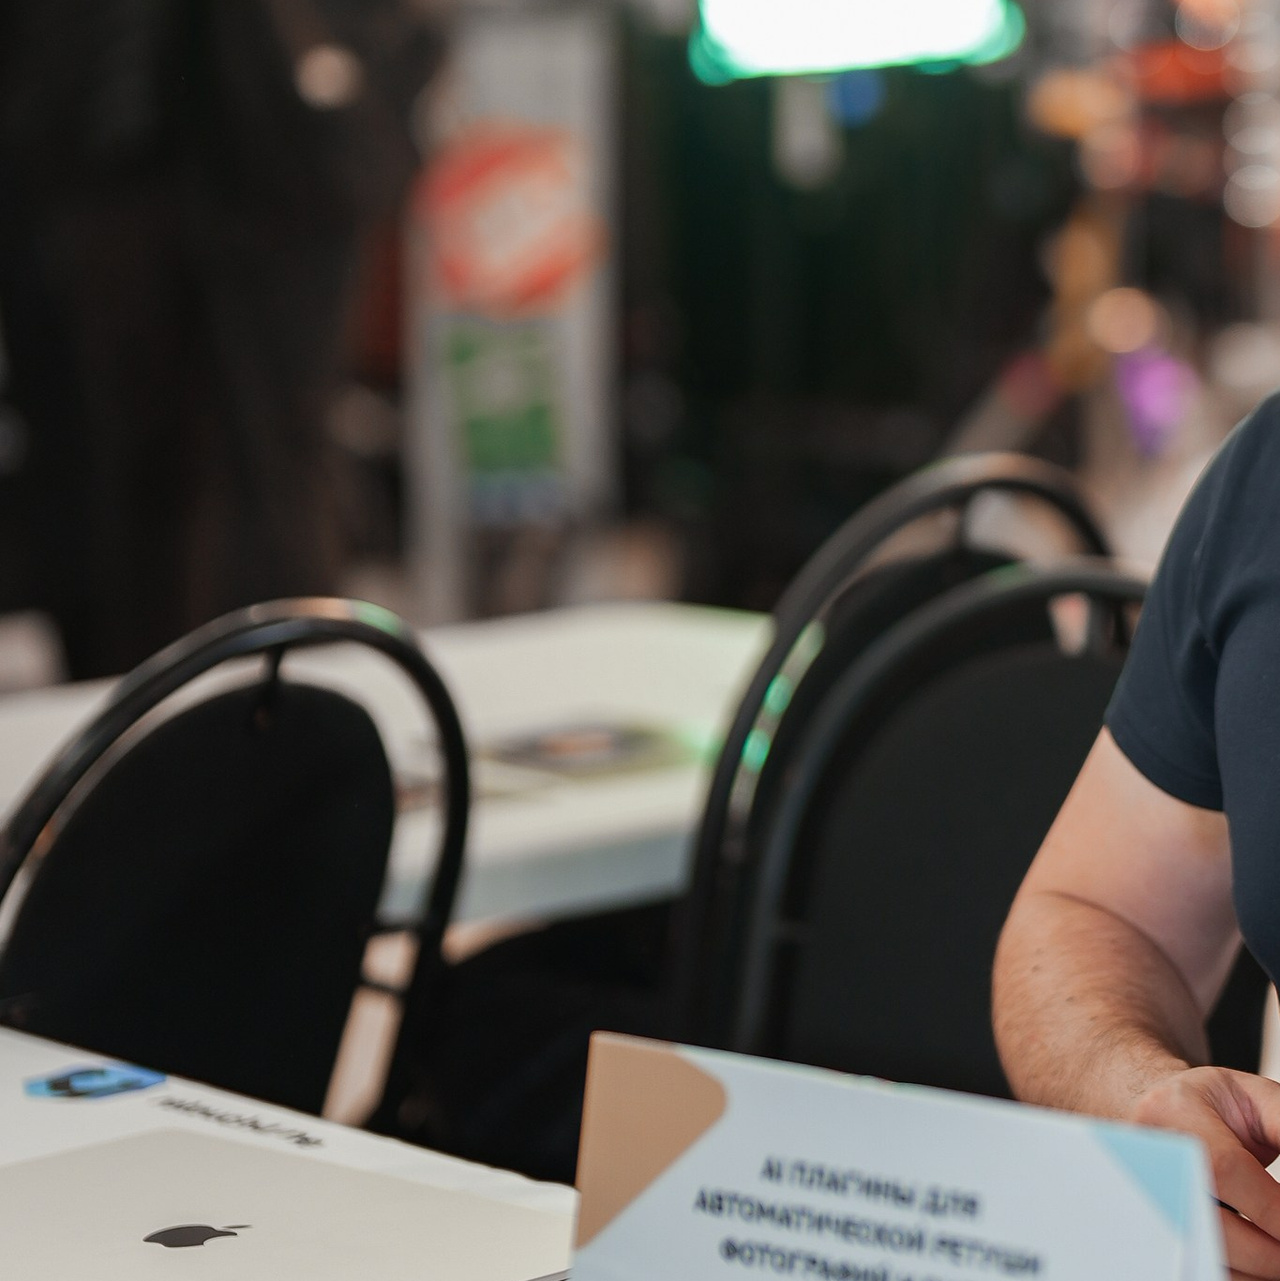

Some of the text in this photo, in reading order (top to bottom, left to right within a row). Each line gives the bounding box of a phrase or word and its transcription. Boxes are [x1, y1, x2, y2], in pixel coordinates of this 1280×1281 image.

[788, 1160, 915, 1207] ПЛАГИНЫ
[694, 1188, 1042, 1276] АВТОМАТИЧЕСКОЙ РЕТУШИ
